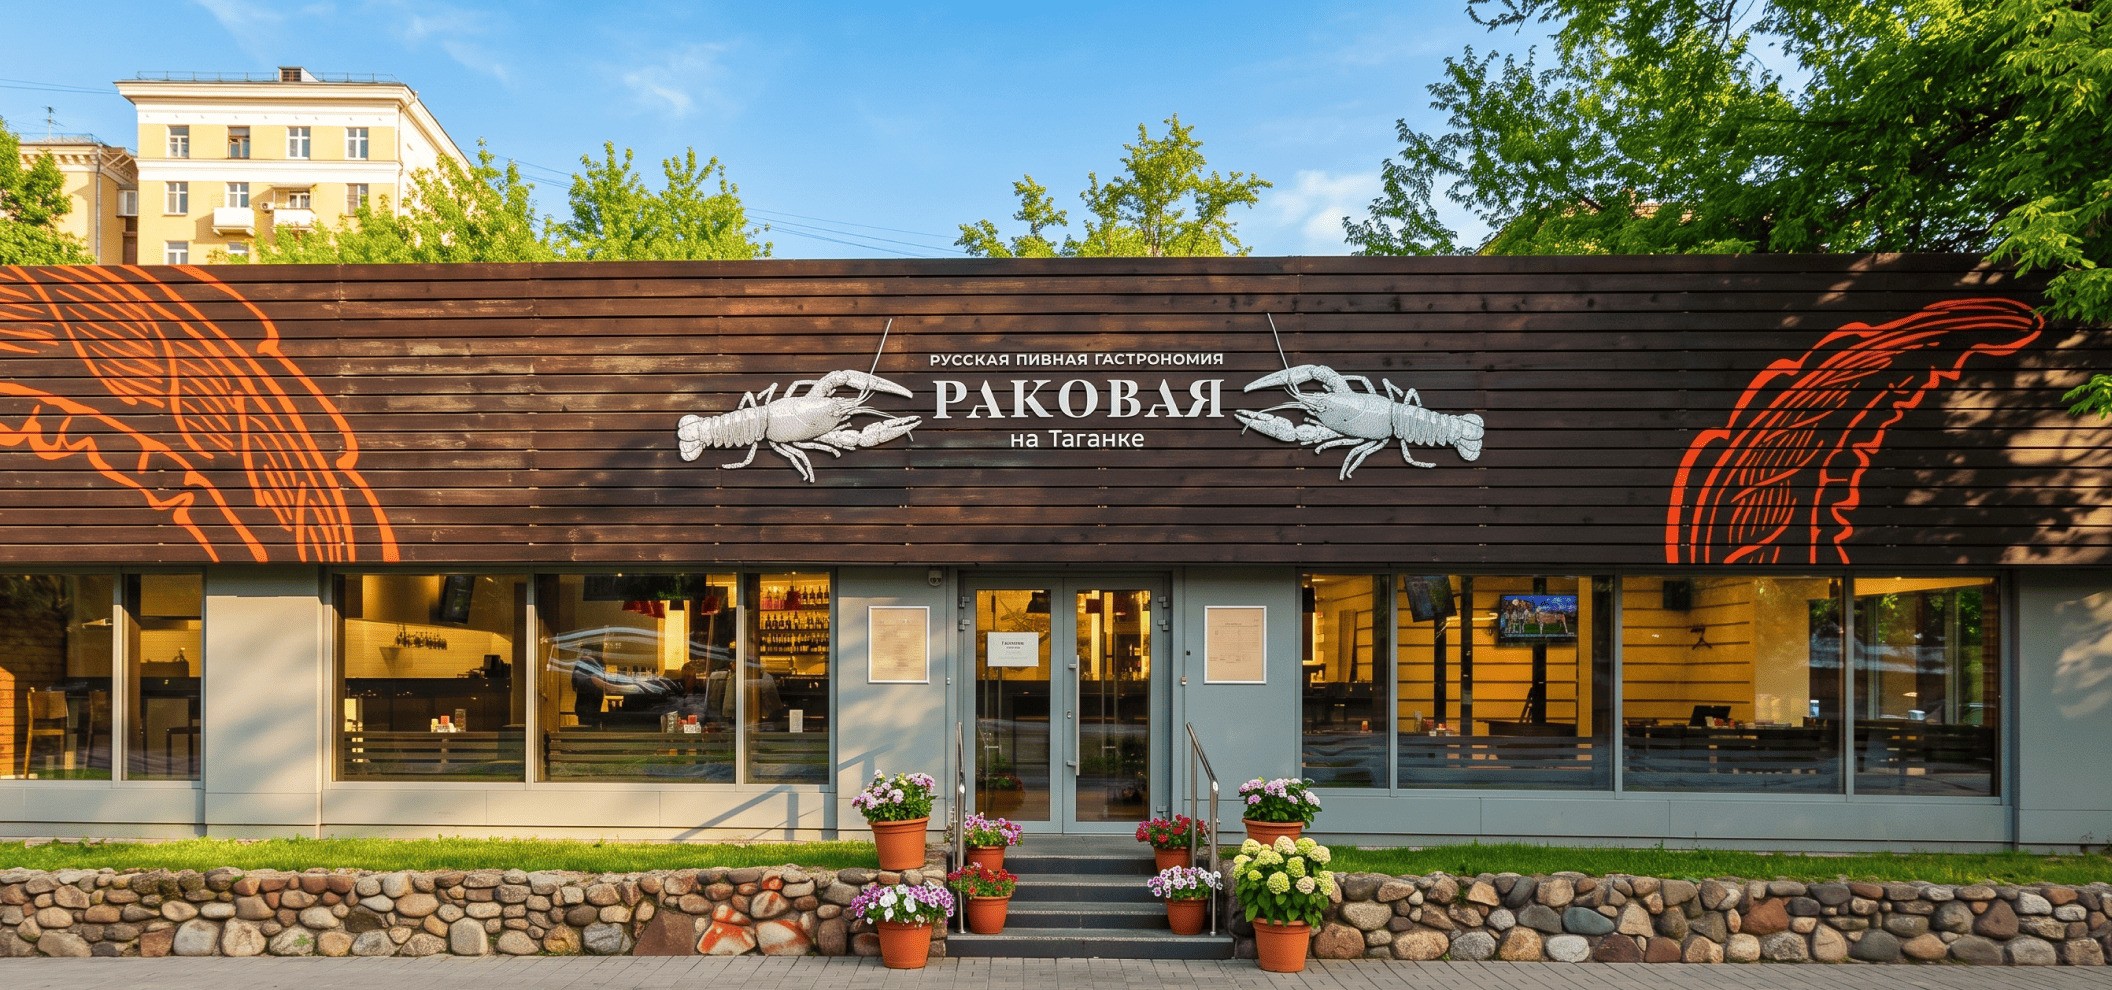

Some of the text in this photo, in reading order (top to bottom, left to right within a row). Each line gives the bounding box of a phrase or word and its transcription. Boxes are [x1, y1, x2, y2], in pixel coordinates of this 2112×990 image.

[930, 353, 1224, 366] РУССКАЯ ПИВНАЯ ГАСТРОНОМИЯ
[932, 379, 1225, 419] РАКОВАЯ
[1010, 429, 1145, 448] на Таганке
